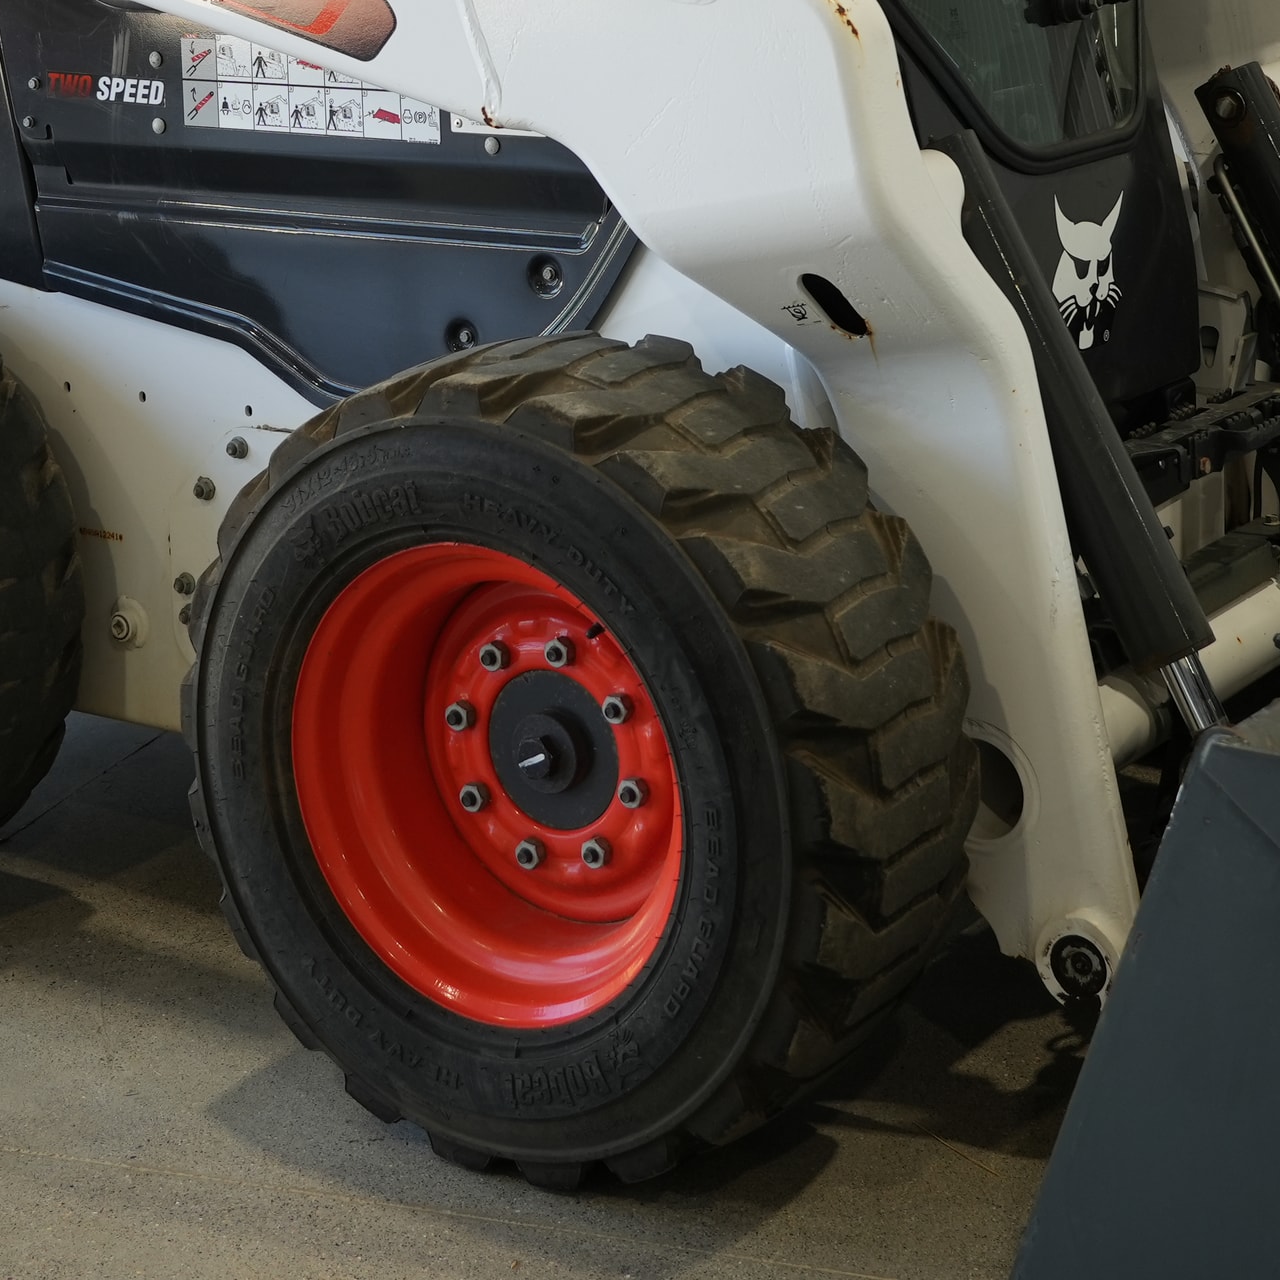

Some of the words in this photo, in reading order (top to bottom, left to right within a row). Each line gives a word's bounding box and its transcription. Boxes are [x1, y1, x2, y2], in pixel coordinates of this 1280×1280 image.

[48, 72, 93, 98] TWO
[97, 76, 165, 105] SPEED
[323, 480, 422, 544] Bobcat
[464, 492, 564, 545] HEAVY
[567, 545, 636, 614] DUTY
[704, 806, 721, 905] BEAD
[664, 915, 714, 1019] GUARD
